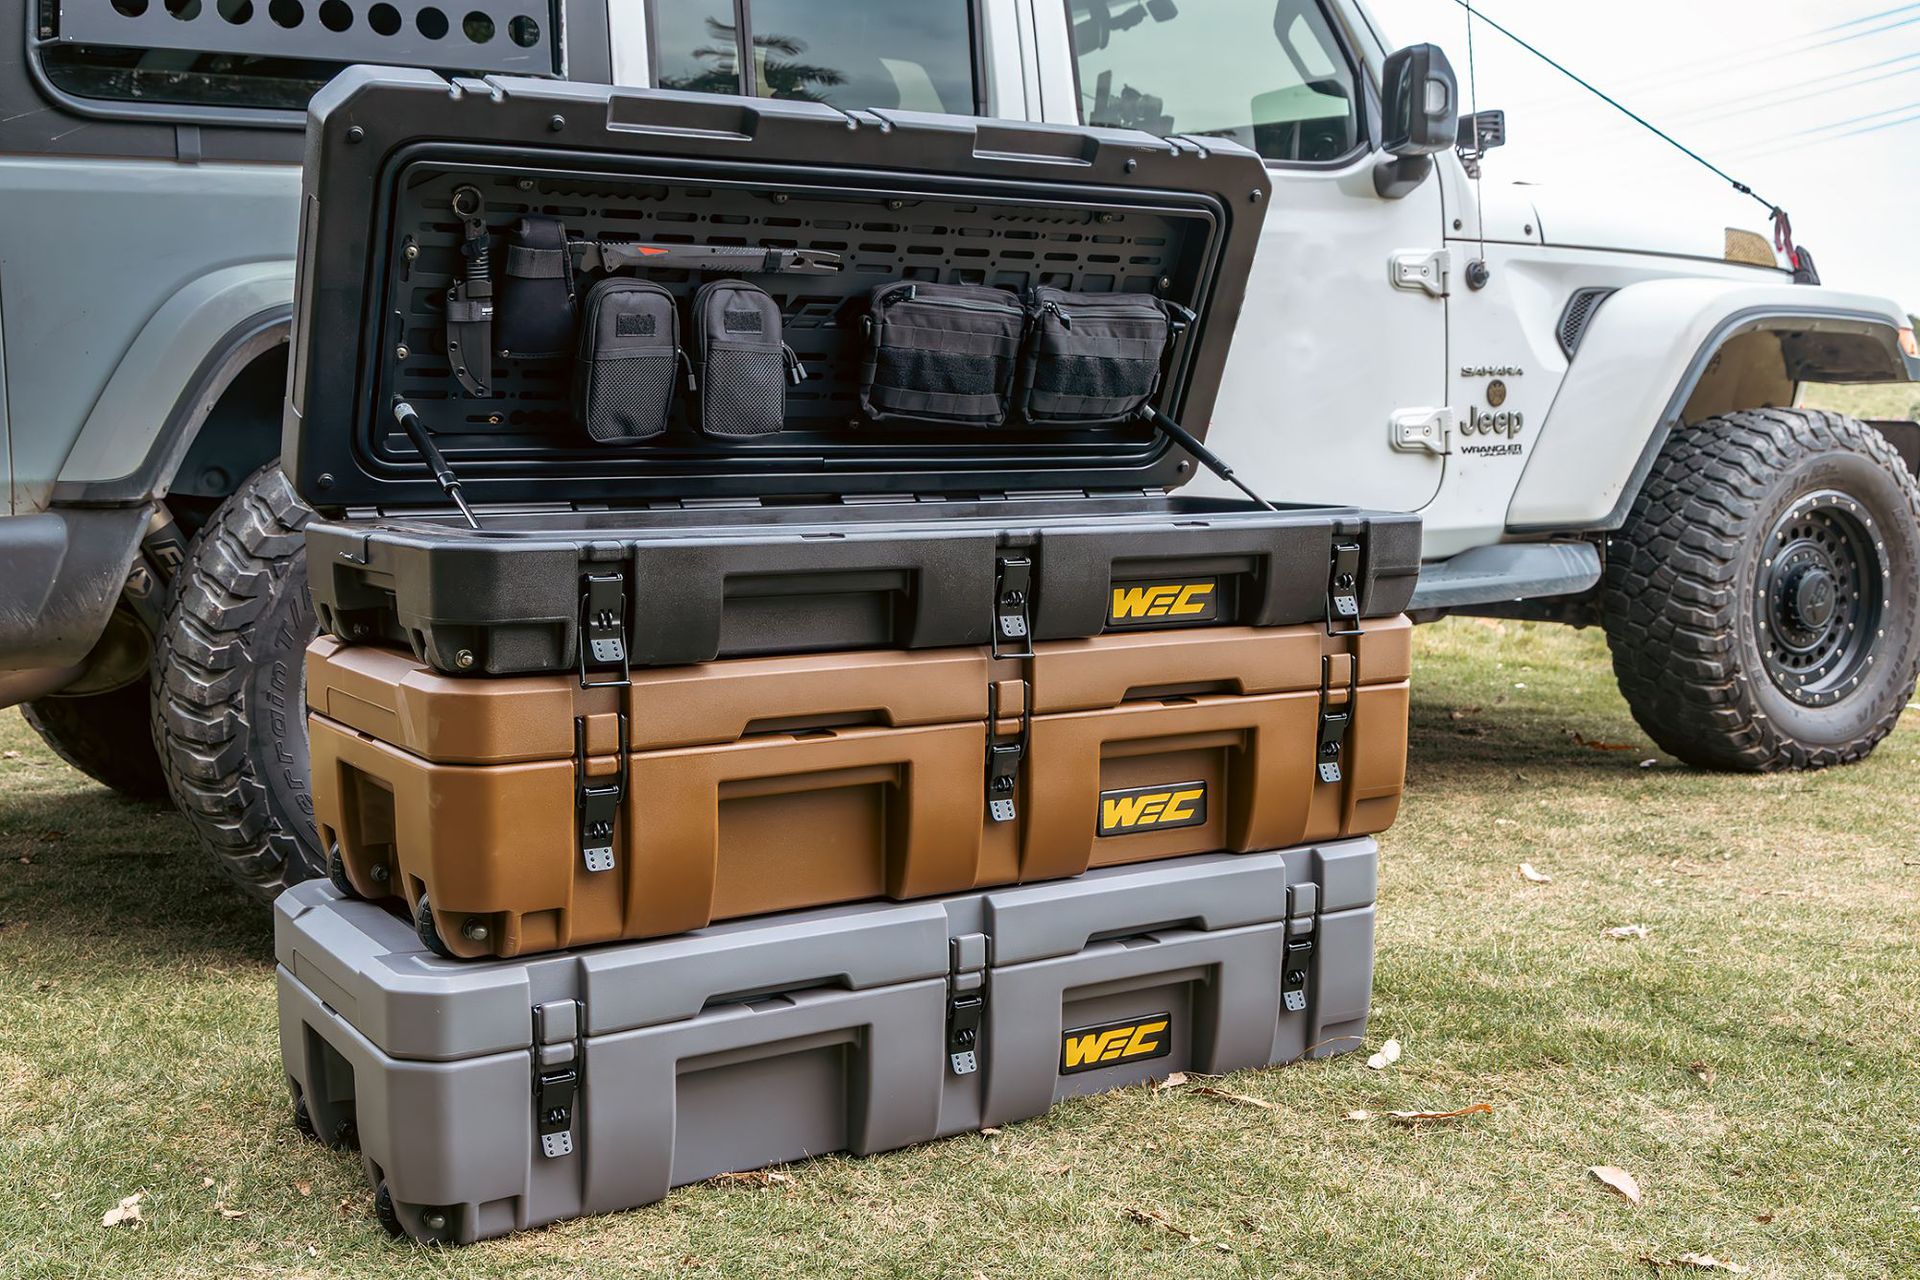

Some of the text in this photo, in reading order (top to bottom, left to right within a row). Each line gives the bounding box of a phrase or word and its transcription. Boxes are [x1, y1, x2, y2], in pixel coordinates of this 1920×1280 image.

[1460, 365, 1524, 378] SAHARA
[1460, 404, 1523, 440] Jeep
[1460, 443, 1522, 454] WRANGLER
[1112, 583, 1215, 618] WEC
[265, 660, 320, 837] errain
[1103, 788, 1204, 829] WEC
[1066, 1020, 1168, 1067] WEC
